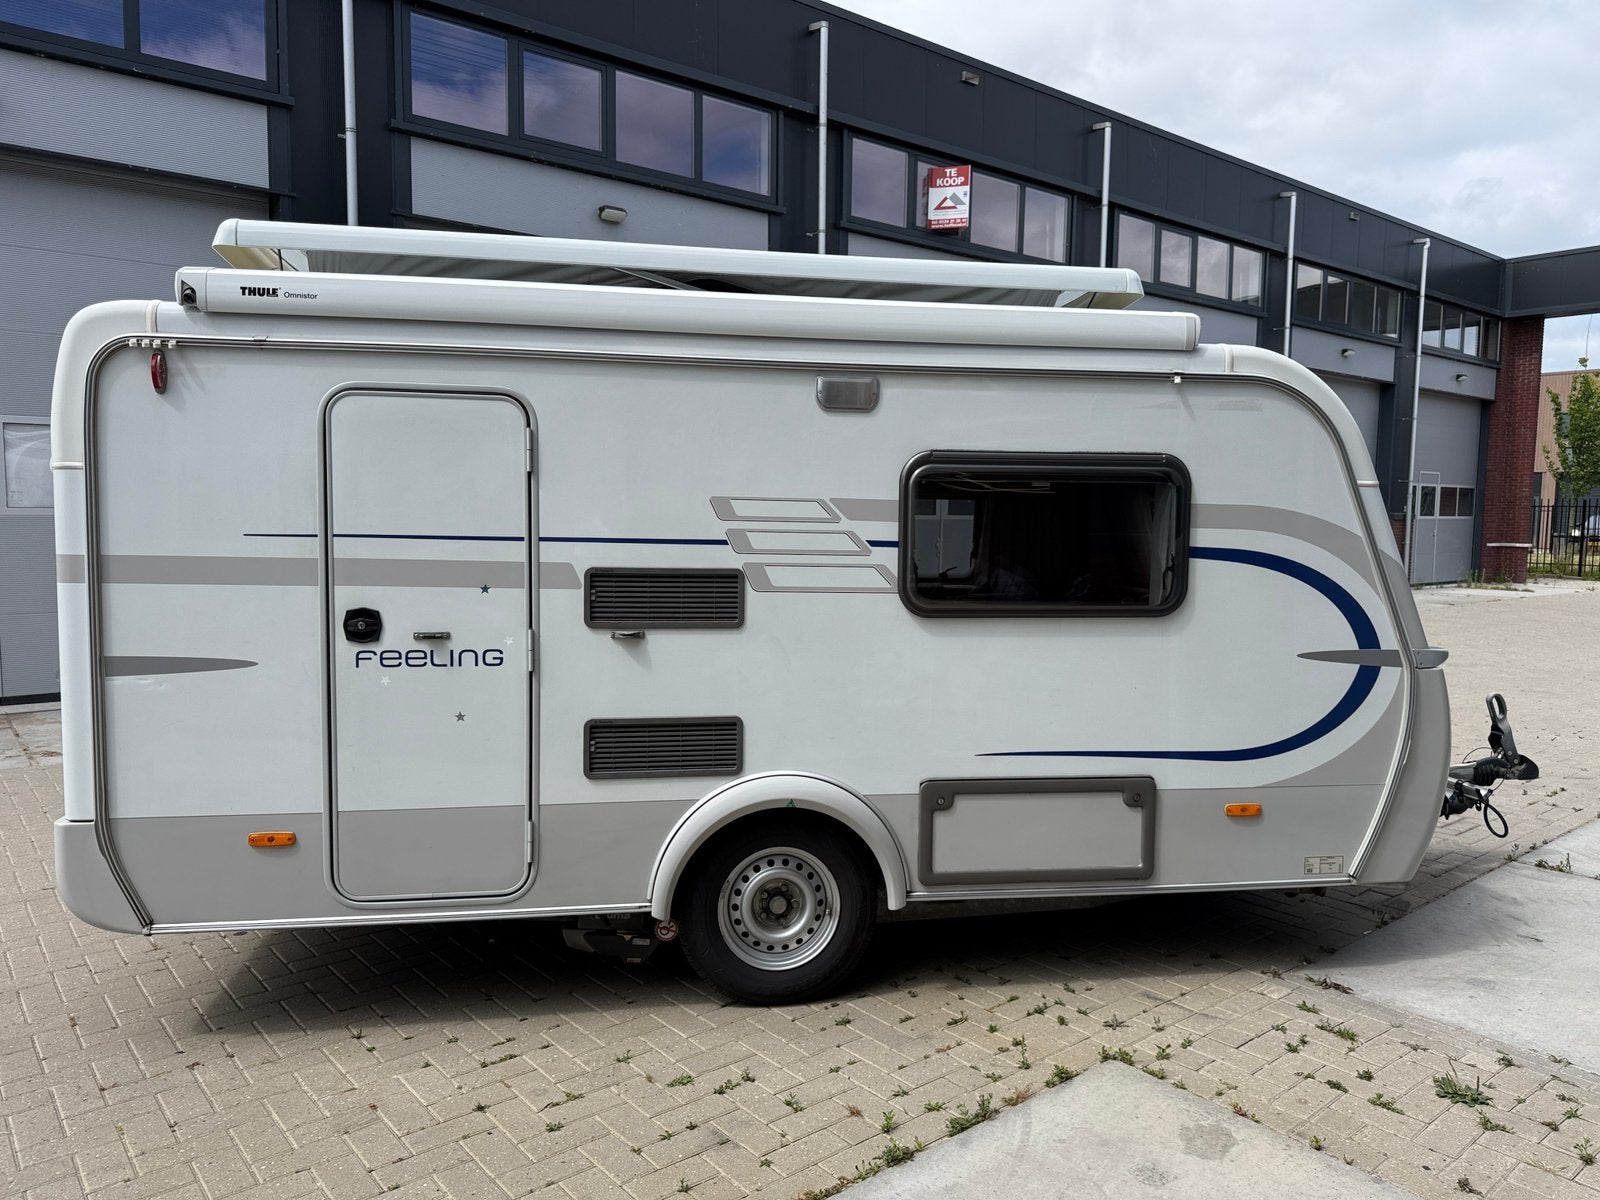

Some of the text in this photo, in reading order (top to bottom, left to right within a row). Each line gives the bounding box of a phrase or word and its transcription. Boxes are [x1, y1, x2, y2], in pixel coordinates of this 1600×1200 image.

[944, 168, 958, 177] TE
[936, 176, 965, 187] KOOP
[240, 286, 318, 300] THULE Omnistor
